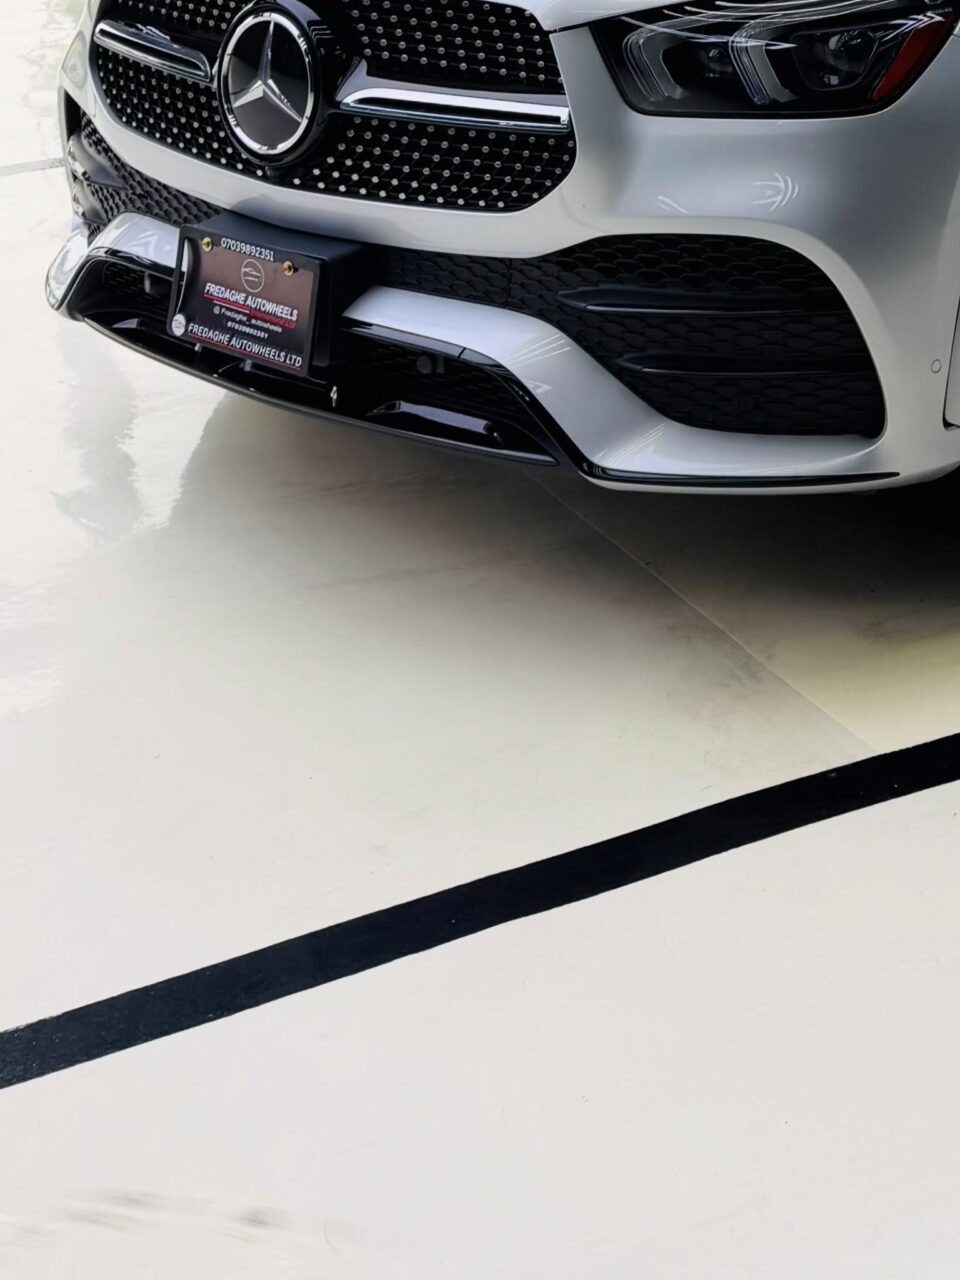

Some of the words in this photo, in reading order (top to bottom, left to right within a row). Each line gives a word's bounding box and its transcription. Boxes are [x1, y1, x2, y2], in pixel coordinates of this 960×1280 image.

[220, 237, 274, 262] 07039892351
[204, 282, 246, 305] FREDAGHE
[245, 295, 298, 321] AUTOWHEELS
[188, 323, 231, 345] FREDAGHE
[229, 336, 285, 363] AUTOWHEELS
[286, 354, 302, 367] LTD
